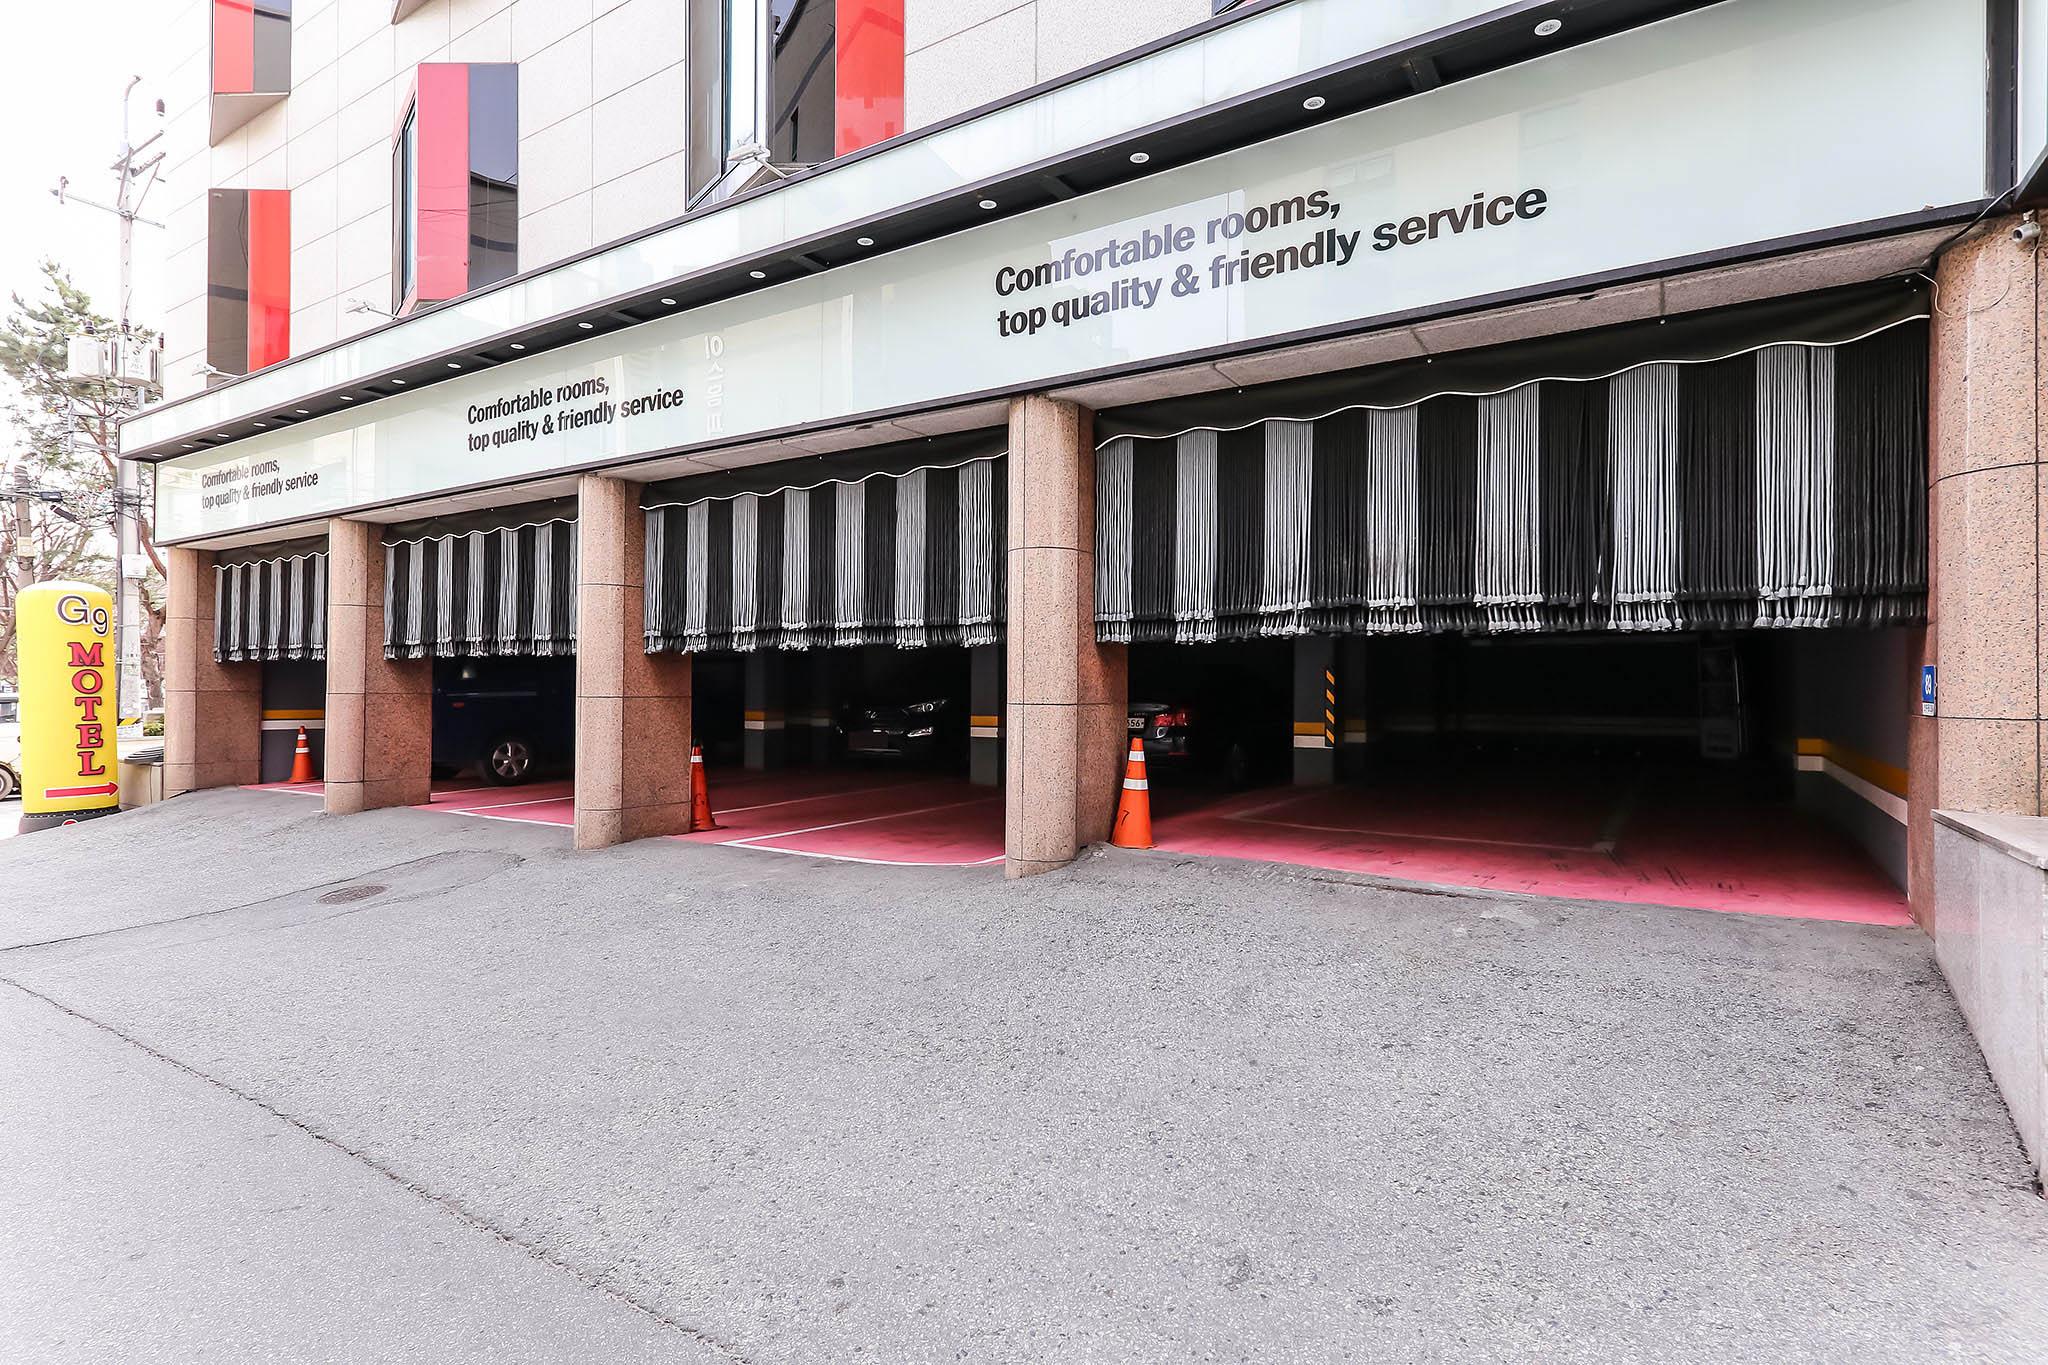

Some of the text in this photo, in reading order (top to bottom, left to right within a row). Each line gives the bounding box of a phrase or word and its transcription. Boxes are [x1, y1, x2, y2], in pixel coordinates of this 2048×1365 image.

[995, 190, 1341, 297] Comfortable rooms,
[997, 187, 1548, 338] top quality & friendly service
[467, 376, 610, 425] Comfortable rooms,
[467, 388, 684, 452] top quality & friendly service
[201, 459, 281, 489] Comfortable rooms,
[201, 471, 319, 510] top quality & friendly service
[66, 641, 106, 777] MOTEL
